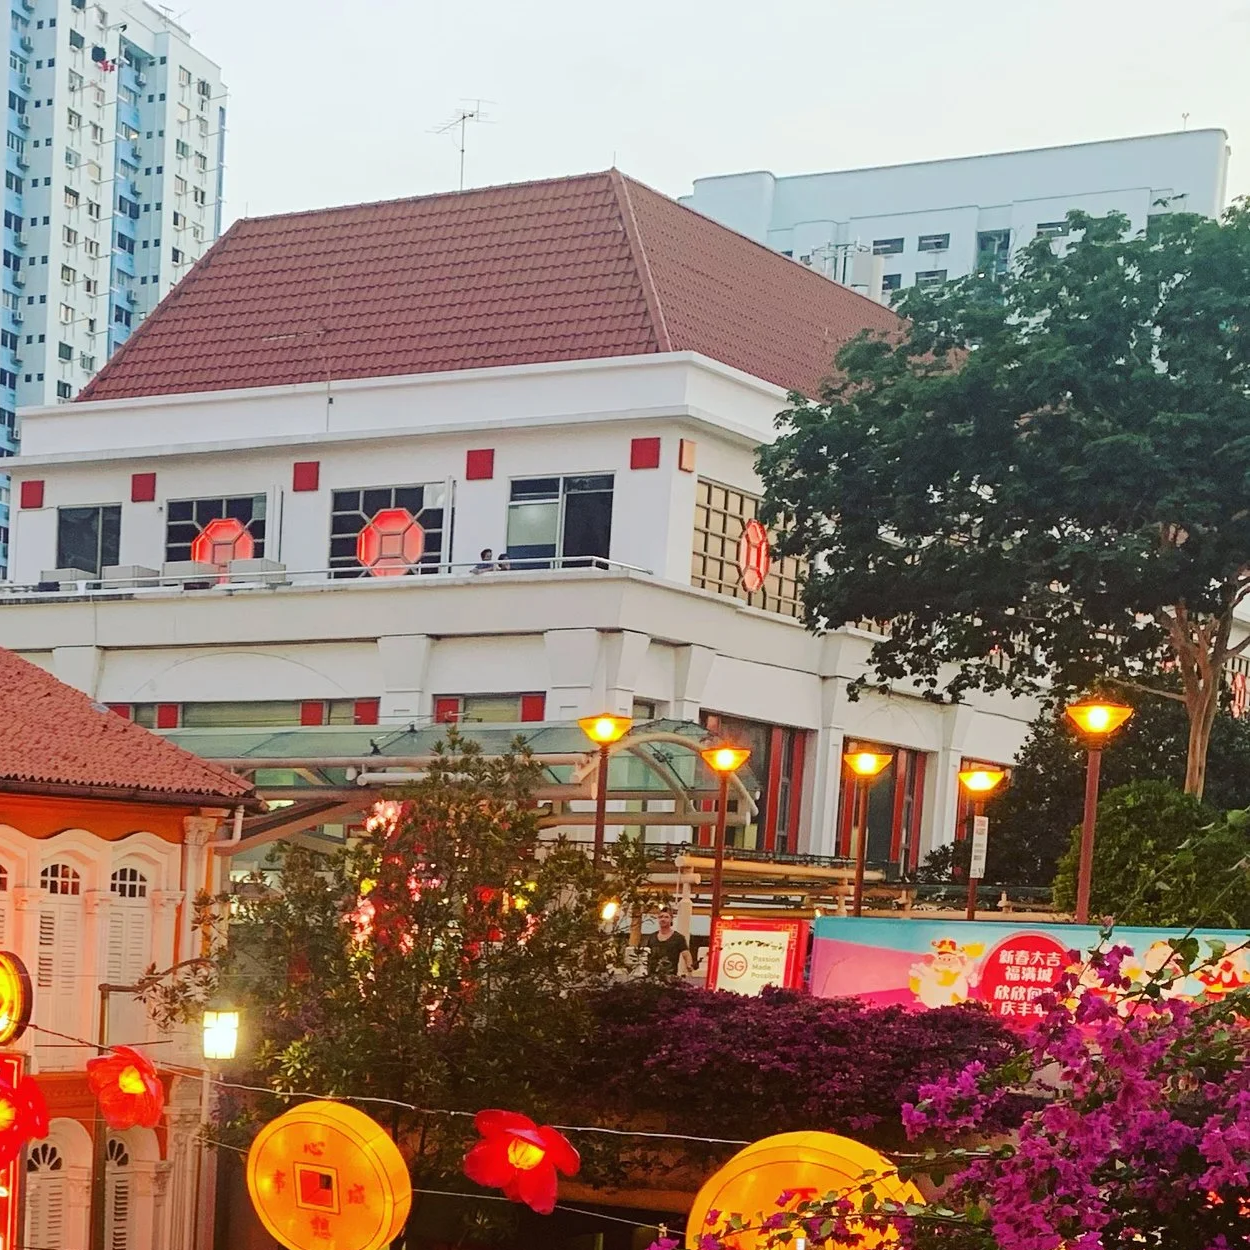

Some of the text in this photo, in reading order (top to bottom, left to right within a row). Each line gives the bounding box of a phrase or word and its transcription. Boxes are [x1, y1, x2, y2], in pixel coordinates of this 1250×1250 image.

[752, 955, 781, 963] Passion
[999, 949, 1061, 967] 新春大吉
[726, 960, 745, 972] SG
[751, 963, 771, 971] Made
[1004, 965, 1053, 983] 福满城
